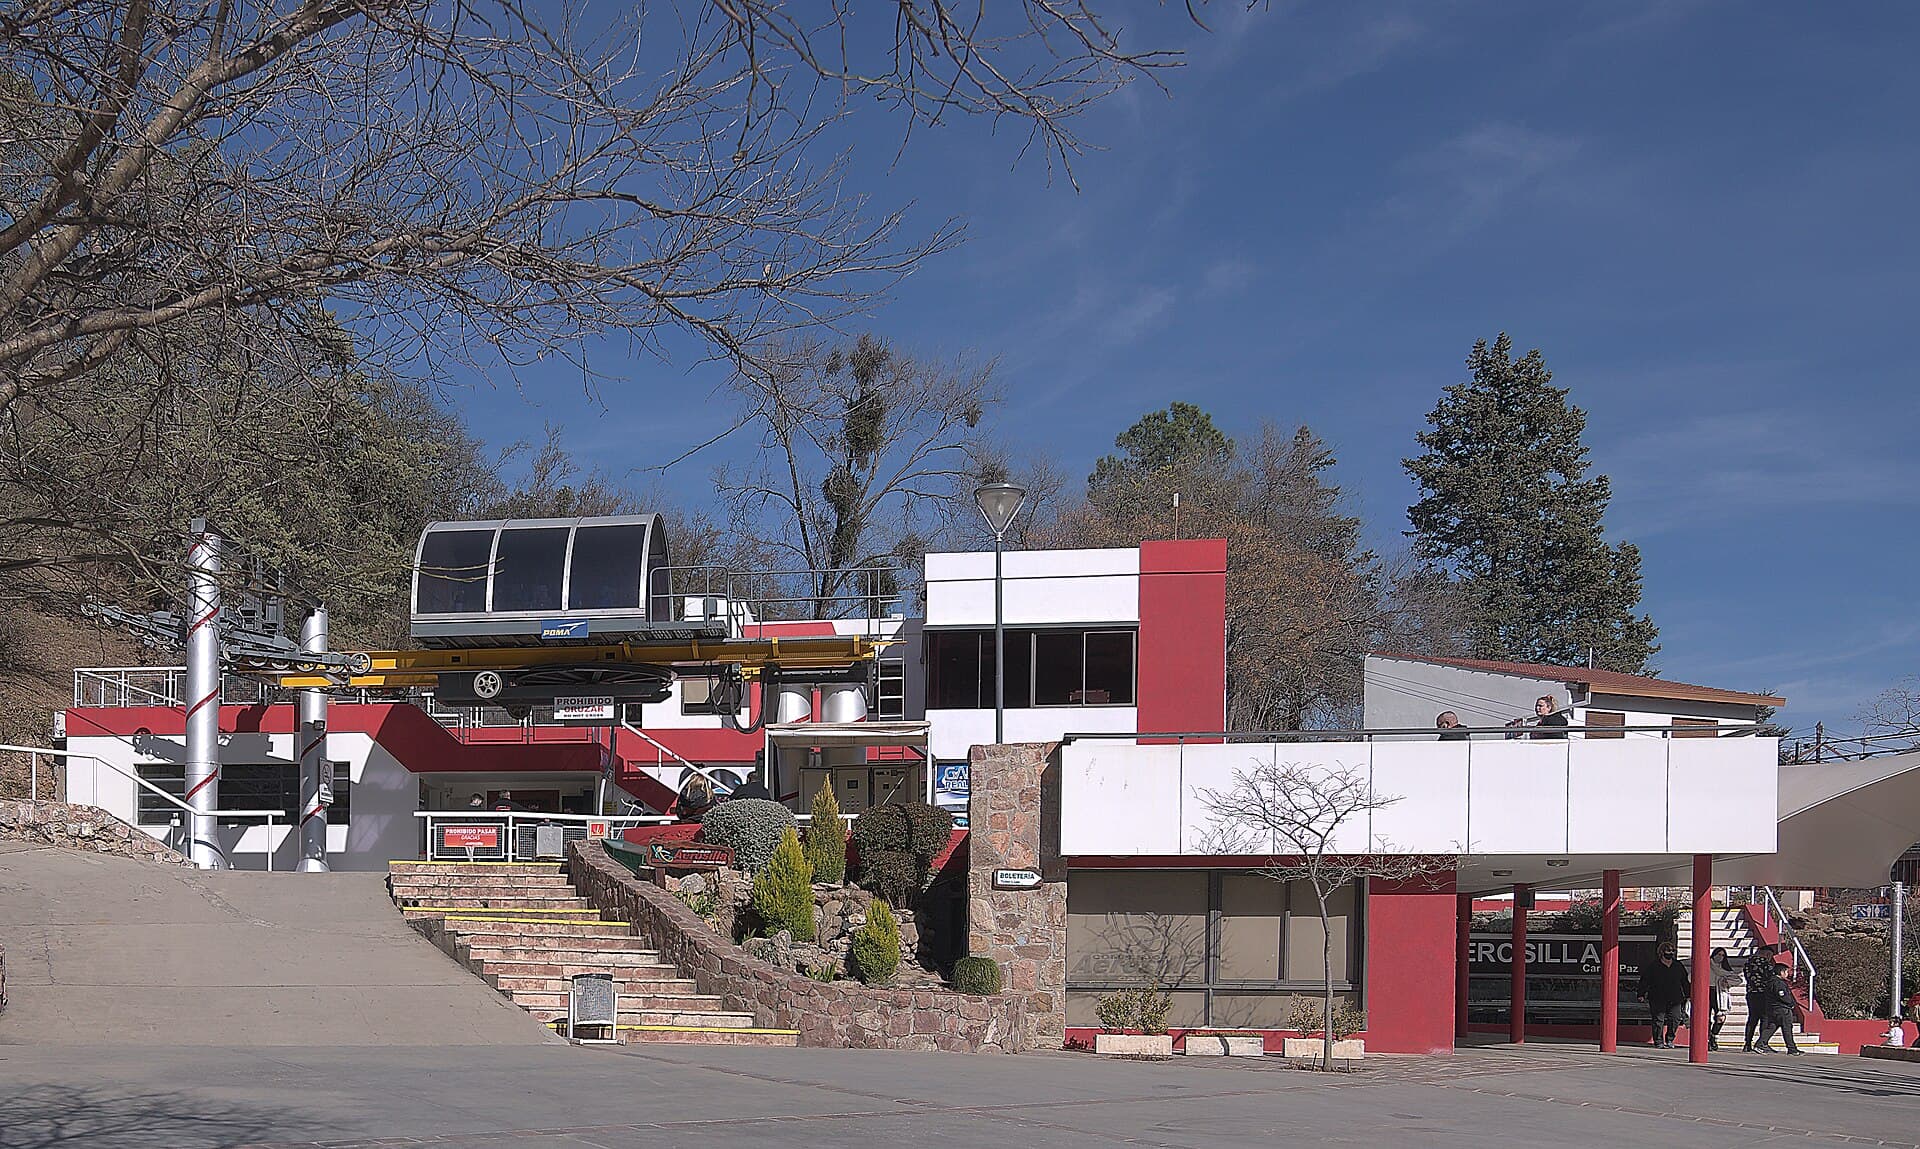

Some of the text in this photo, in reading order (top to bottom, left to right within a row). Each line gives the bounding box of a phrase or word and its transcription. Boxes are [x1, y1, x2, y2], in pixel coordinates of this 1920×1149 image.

[674, 849, 728, 860] Aerosilla
[1469, 942, 1601, 963] EROSILLA
[1582, 963, 1639, 973] Car Paz
